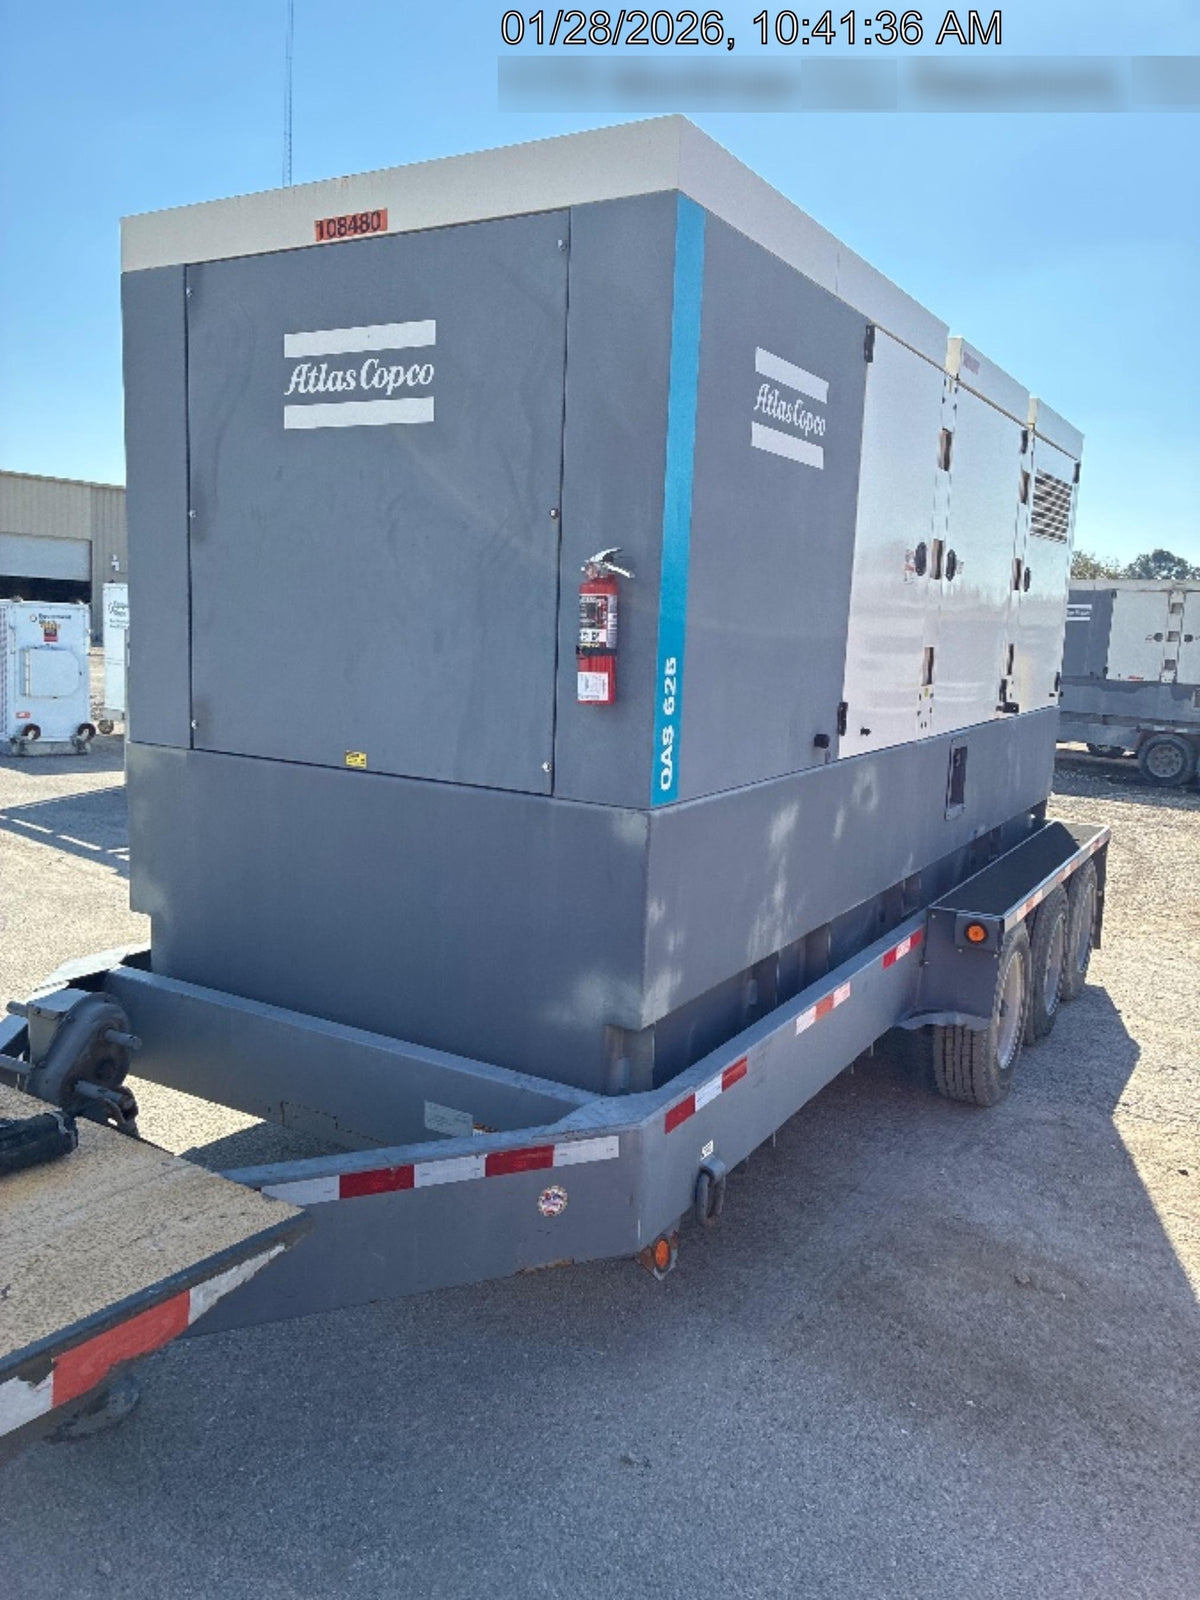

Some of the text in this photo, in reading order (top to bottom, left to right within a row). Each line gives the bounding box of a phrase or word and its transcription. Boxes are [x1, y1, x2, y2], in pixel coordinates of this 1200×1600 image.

[315, 211, 382, 241] 108480
[284, 357, 435, 396] Atlas Copco
[753, 383, 826, 437] Atlas Copco
[660, 656, 677, 791] QAS 625
